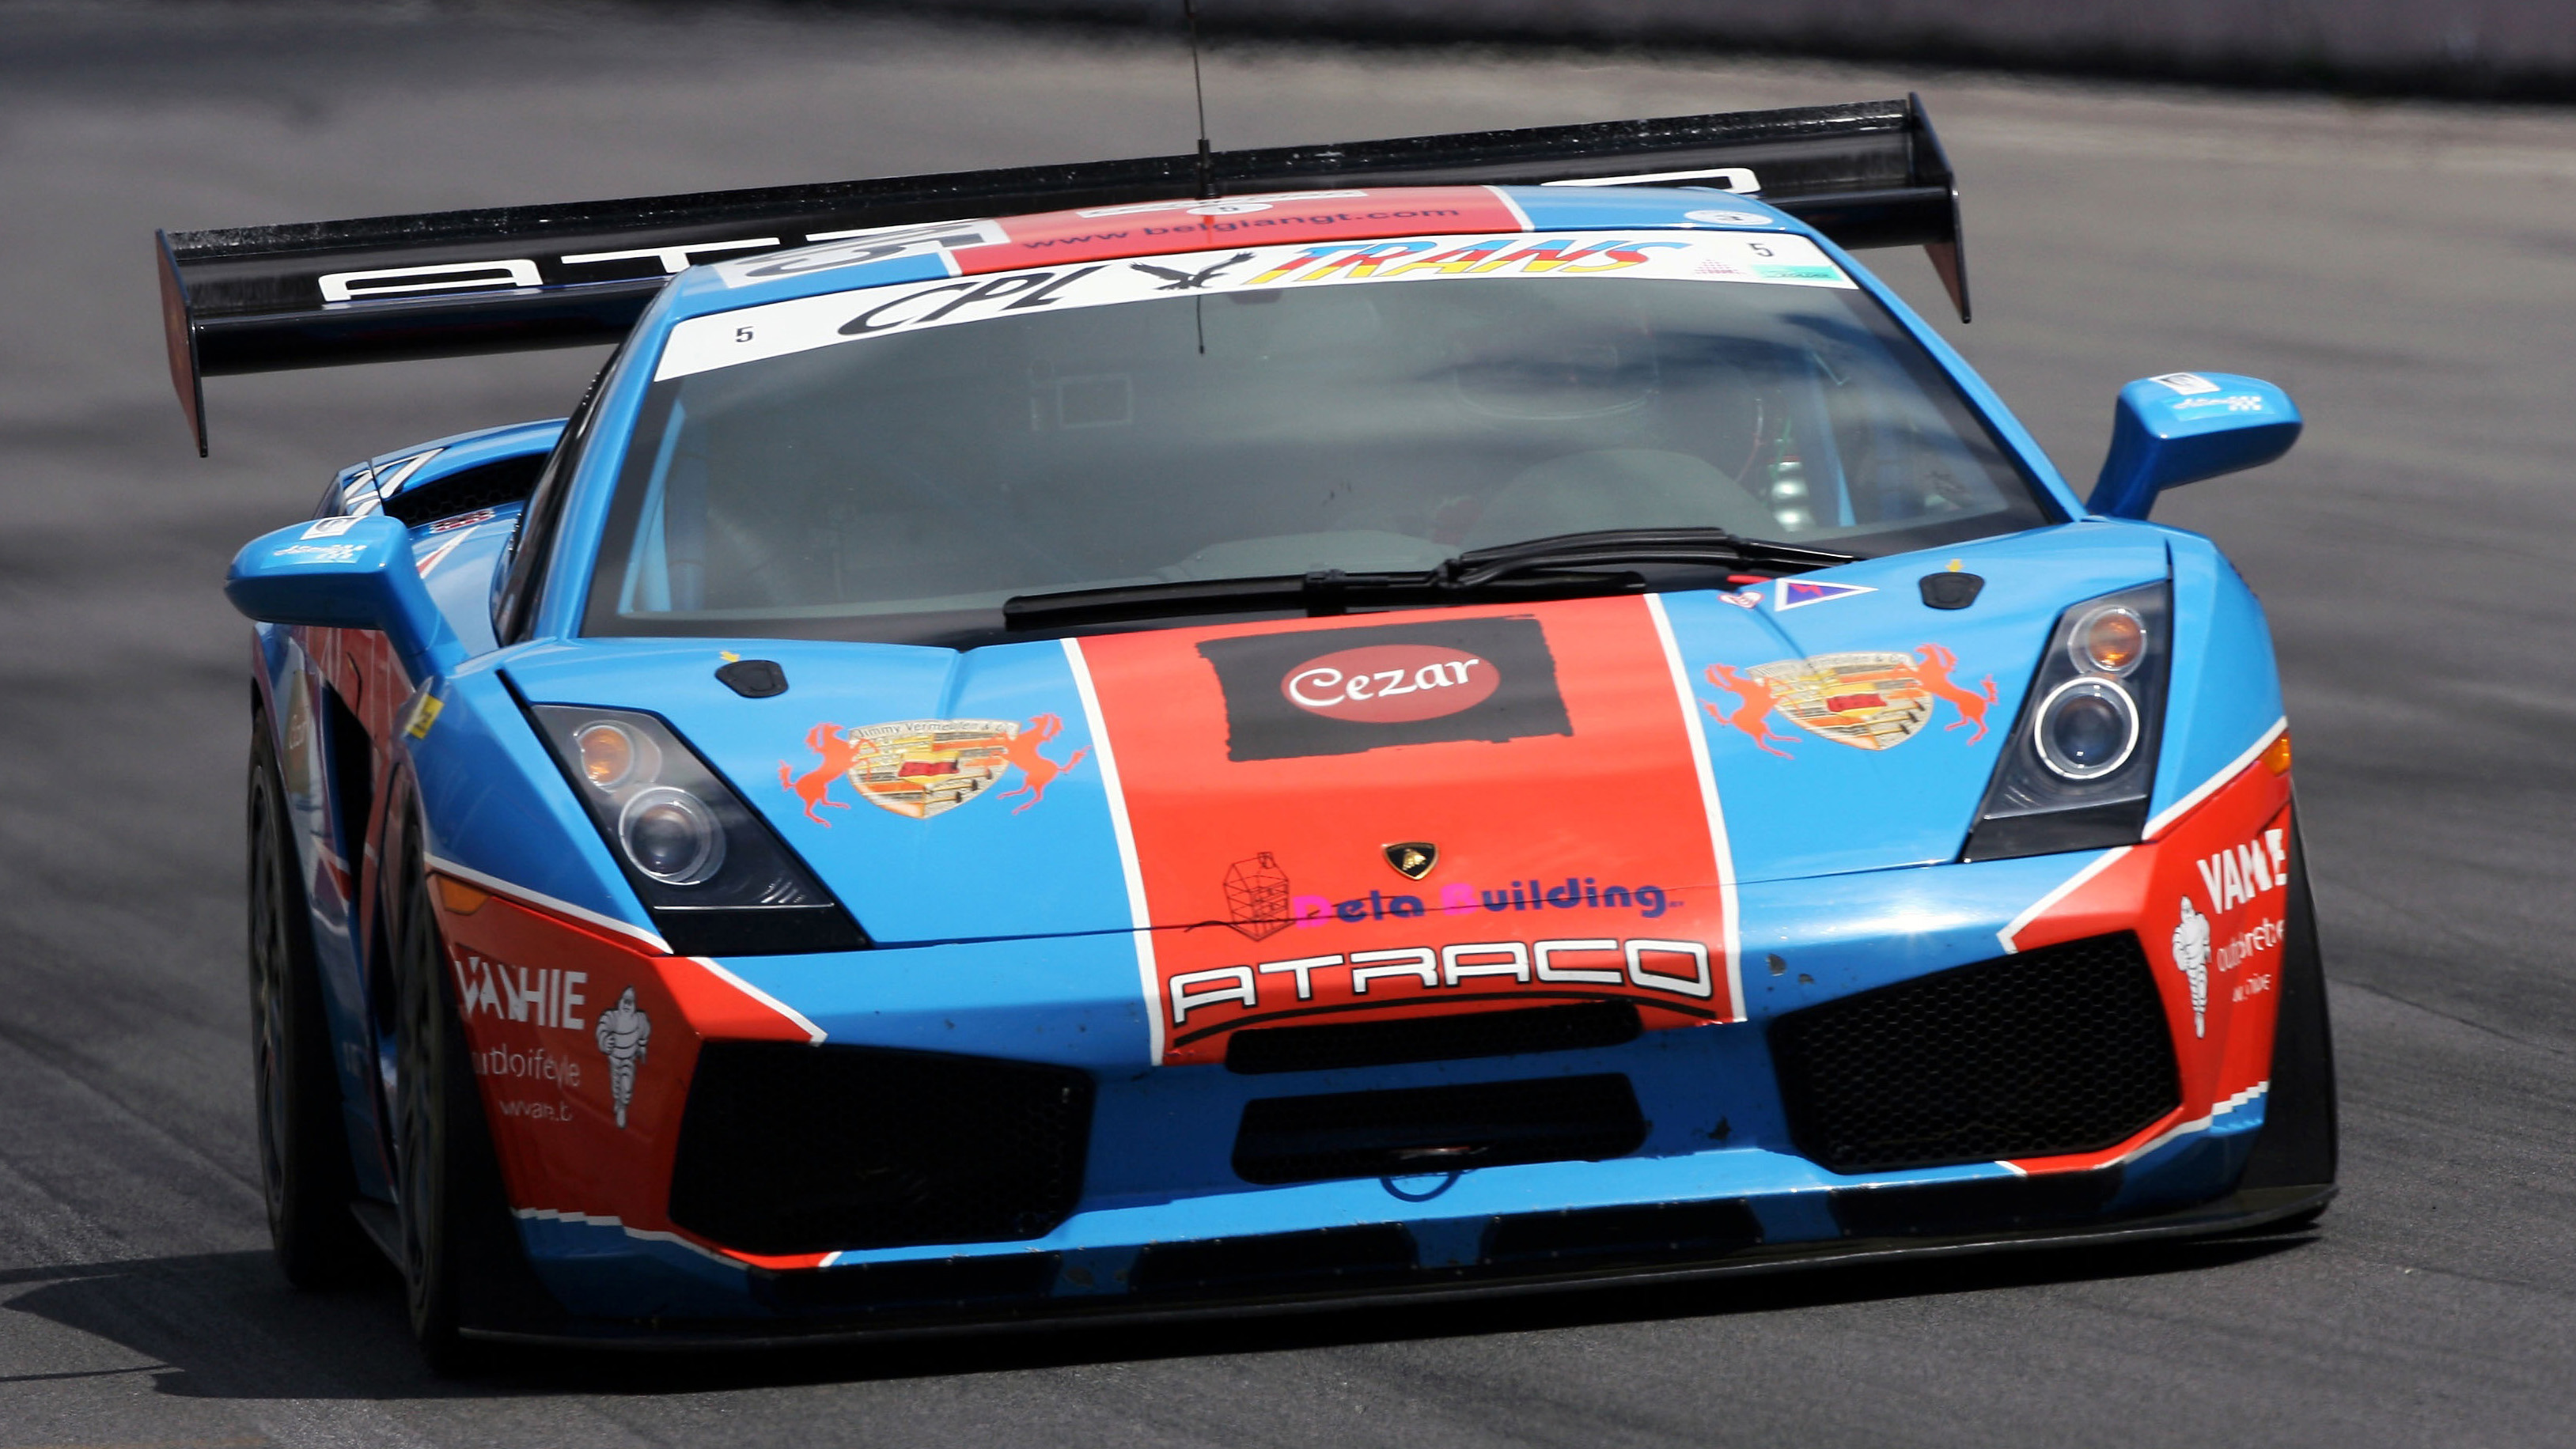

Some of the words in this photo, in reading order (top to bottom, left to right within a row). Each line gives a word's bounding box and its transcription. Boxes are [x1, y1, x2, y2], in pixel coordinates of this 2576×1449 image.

[1748, 243, 1774, 258] 5
[837, 263, 1121, 336] CPL
[1244, 239, 1692, 286] TRANS
[736, 325, 754, 344] 5
[1290, 658, 1479, 707] Cezar
[1293, 890, 1426, 929] Dela
[1440, 877, 1669, 918] Building
[1169, 938, 1714, 1027] ATRACO
